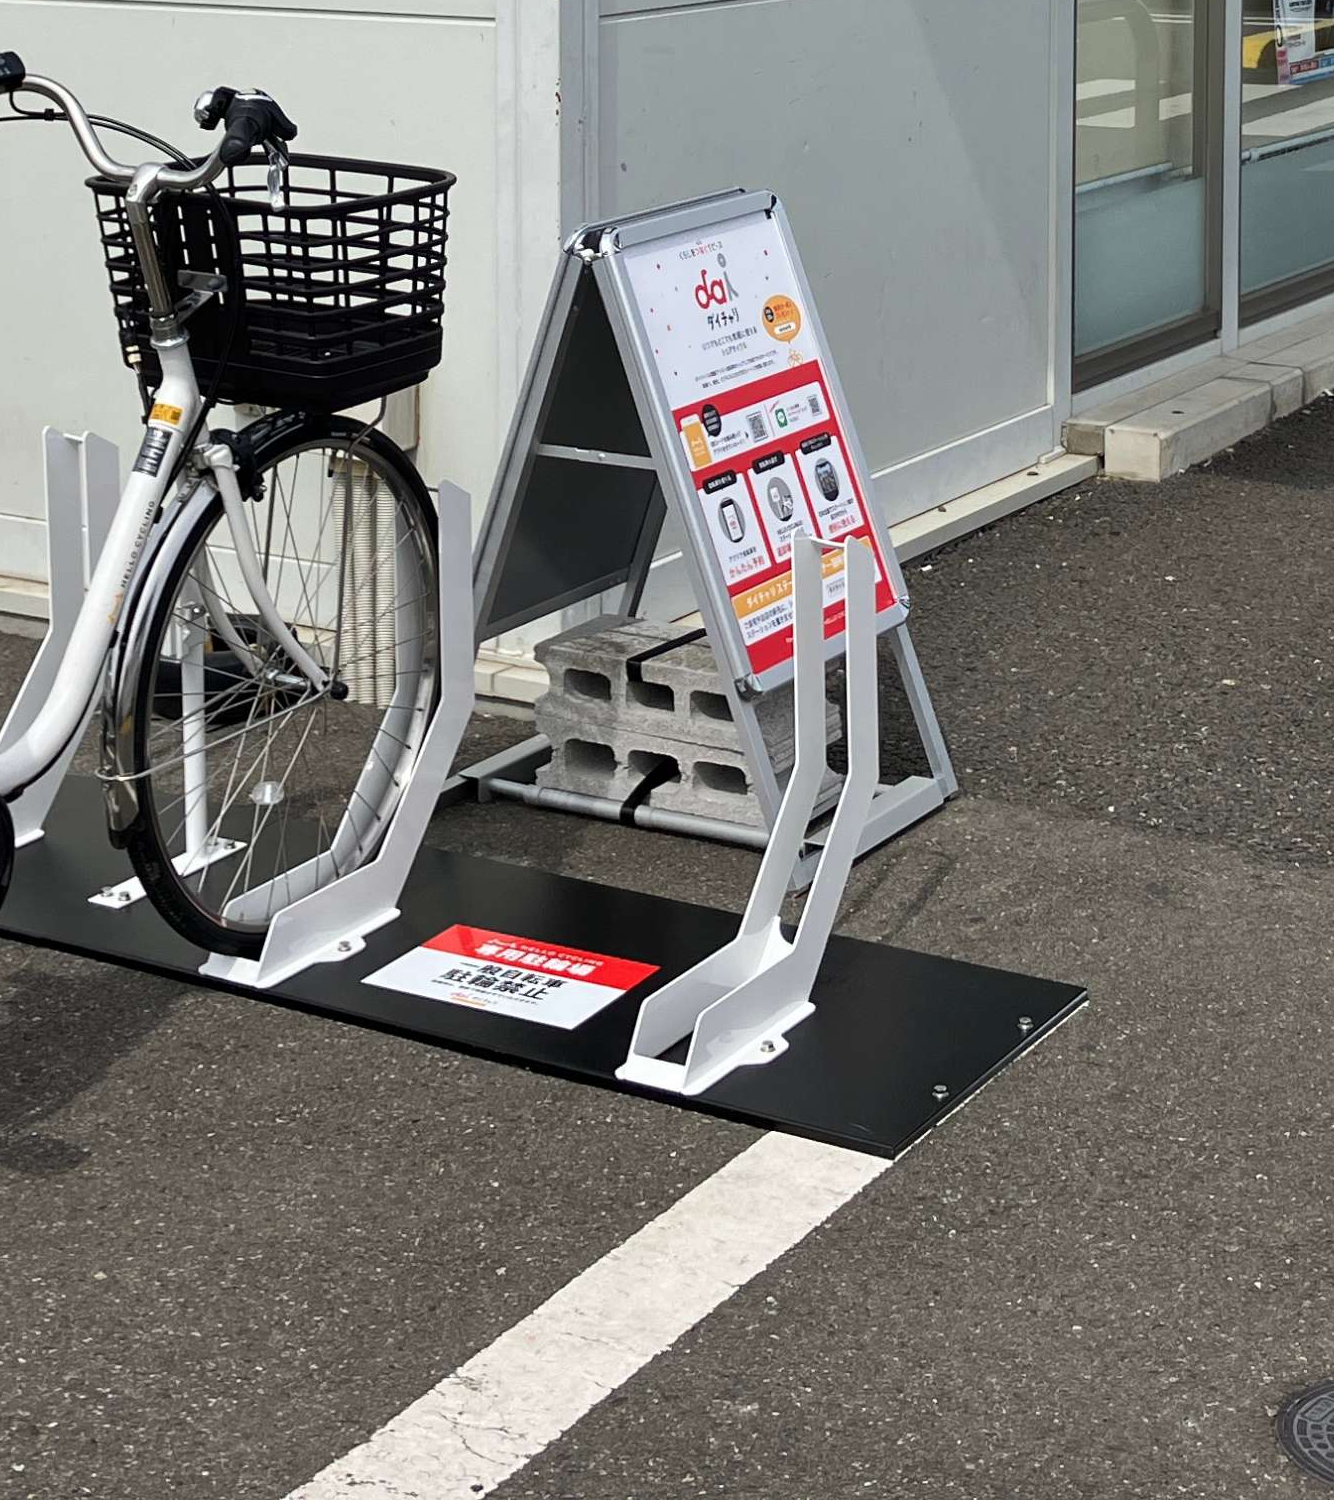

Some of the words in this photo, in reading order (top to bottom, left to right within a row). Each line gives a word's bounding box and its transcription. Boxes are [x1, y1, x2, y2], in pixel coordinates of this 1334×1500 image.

[695, 252, 740, 309] dai
[707, 307, 740, 330] ダイチャリ
[120, 551, 138, 589] HELLO
[134, 500, 155, 548] CYCLING
[439, 968, 549, 1001] 駐輪禁止
[460, 961, 569, 989] 一般自転車
